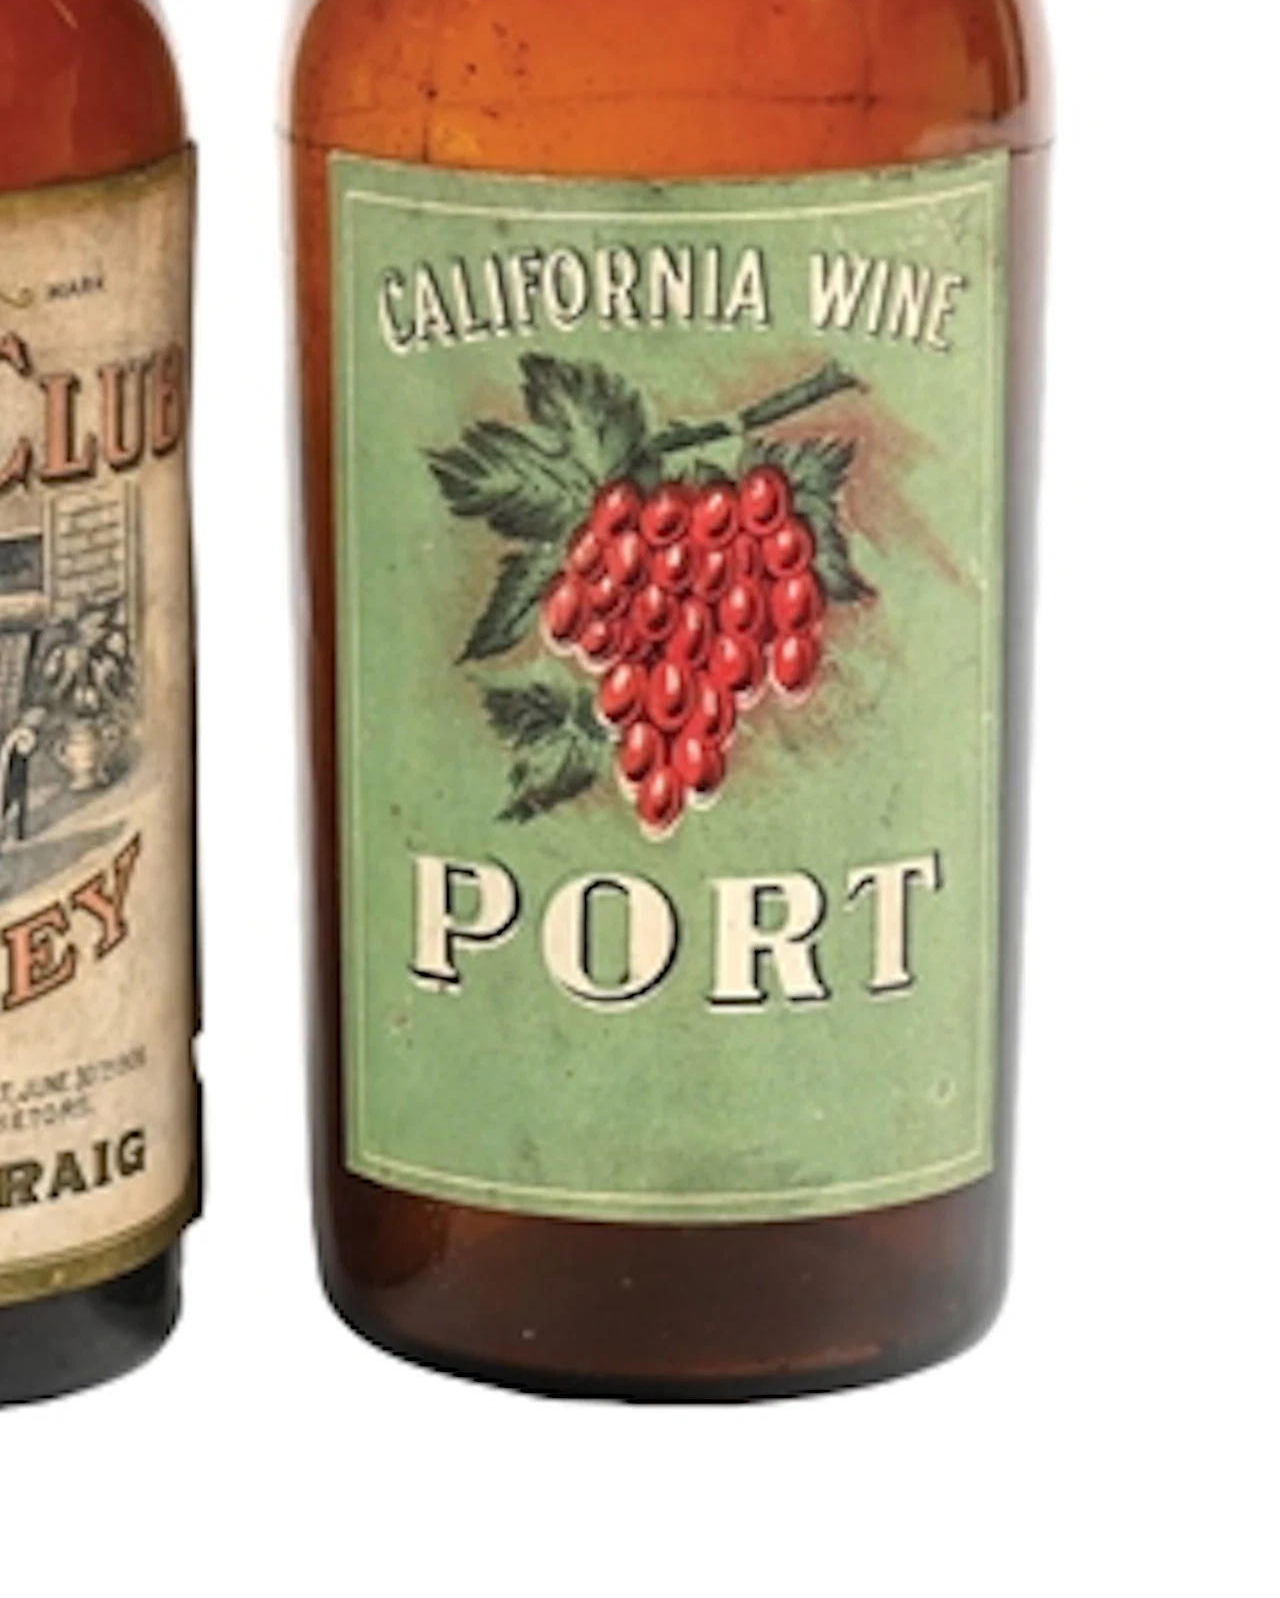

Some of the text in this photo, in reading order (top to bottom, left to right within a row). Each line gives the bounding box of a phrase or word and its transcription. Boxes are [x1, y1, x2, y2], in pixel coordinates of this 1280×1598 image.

[377, 244, 969, 354] CALIFORNIA WINE
[409, 848, 944, 1016] PORT
